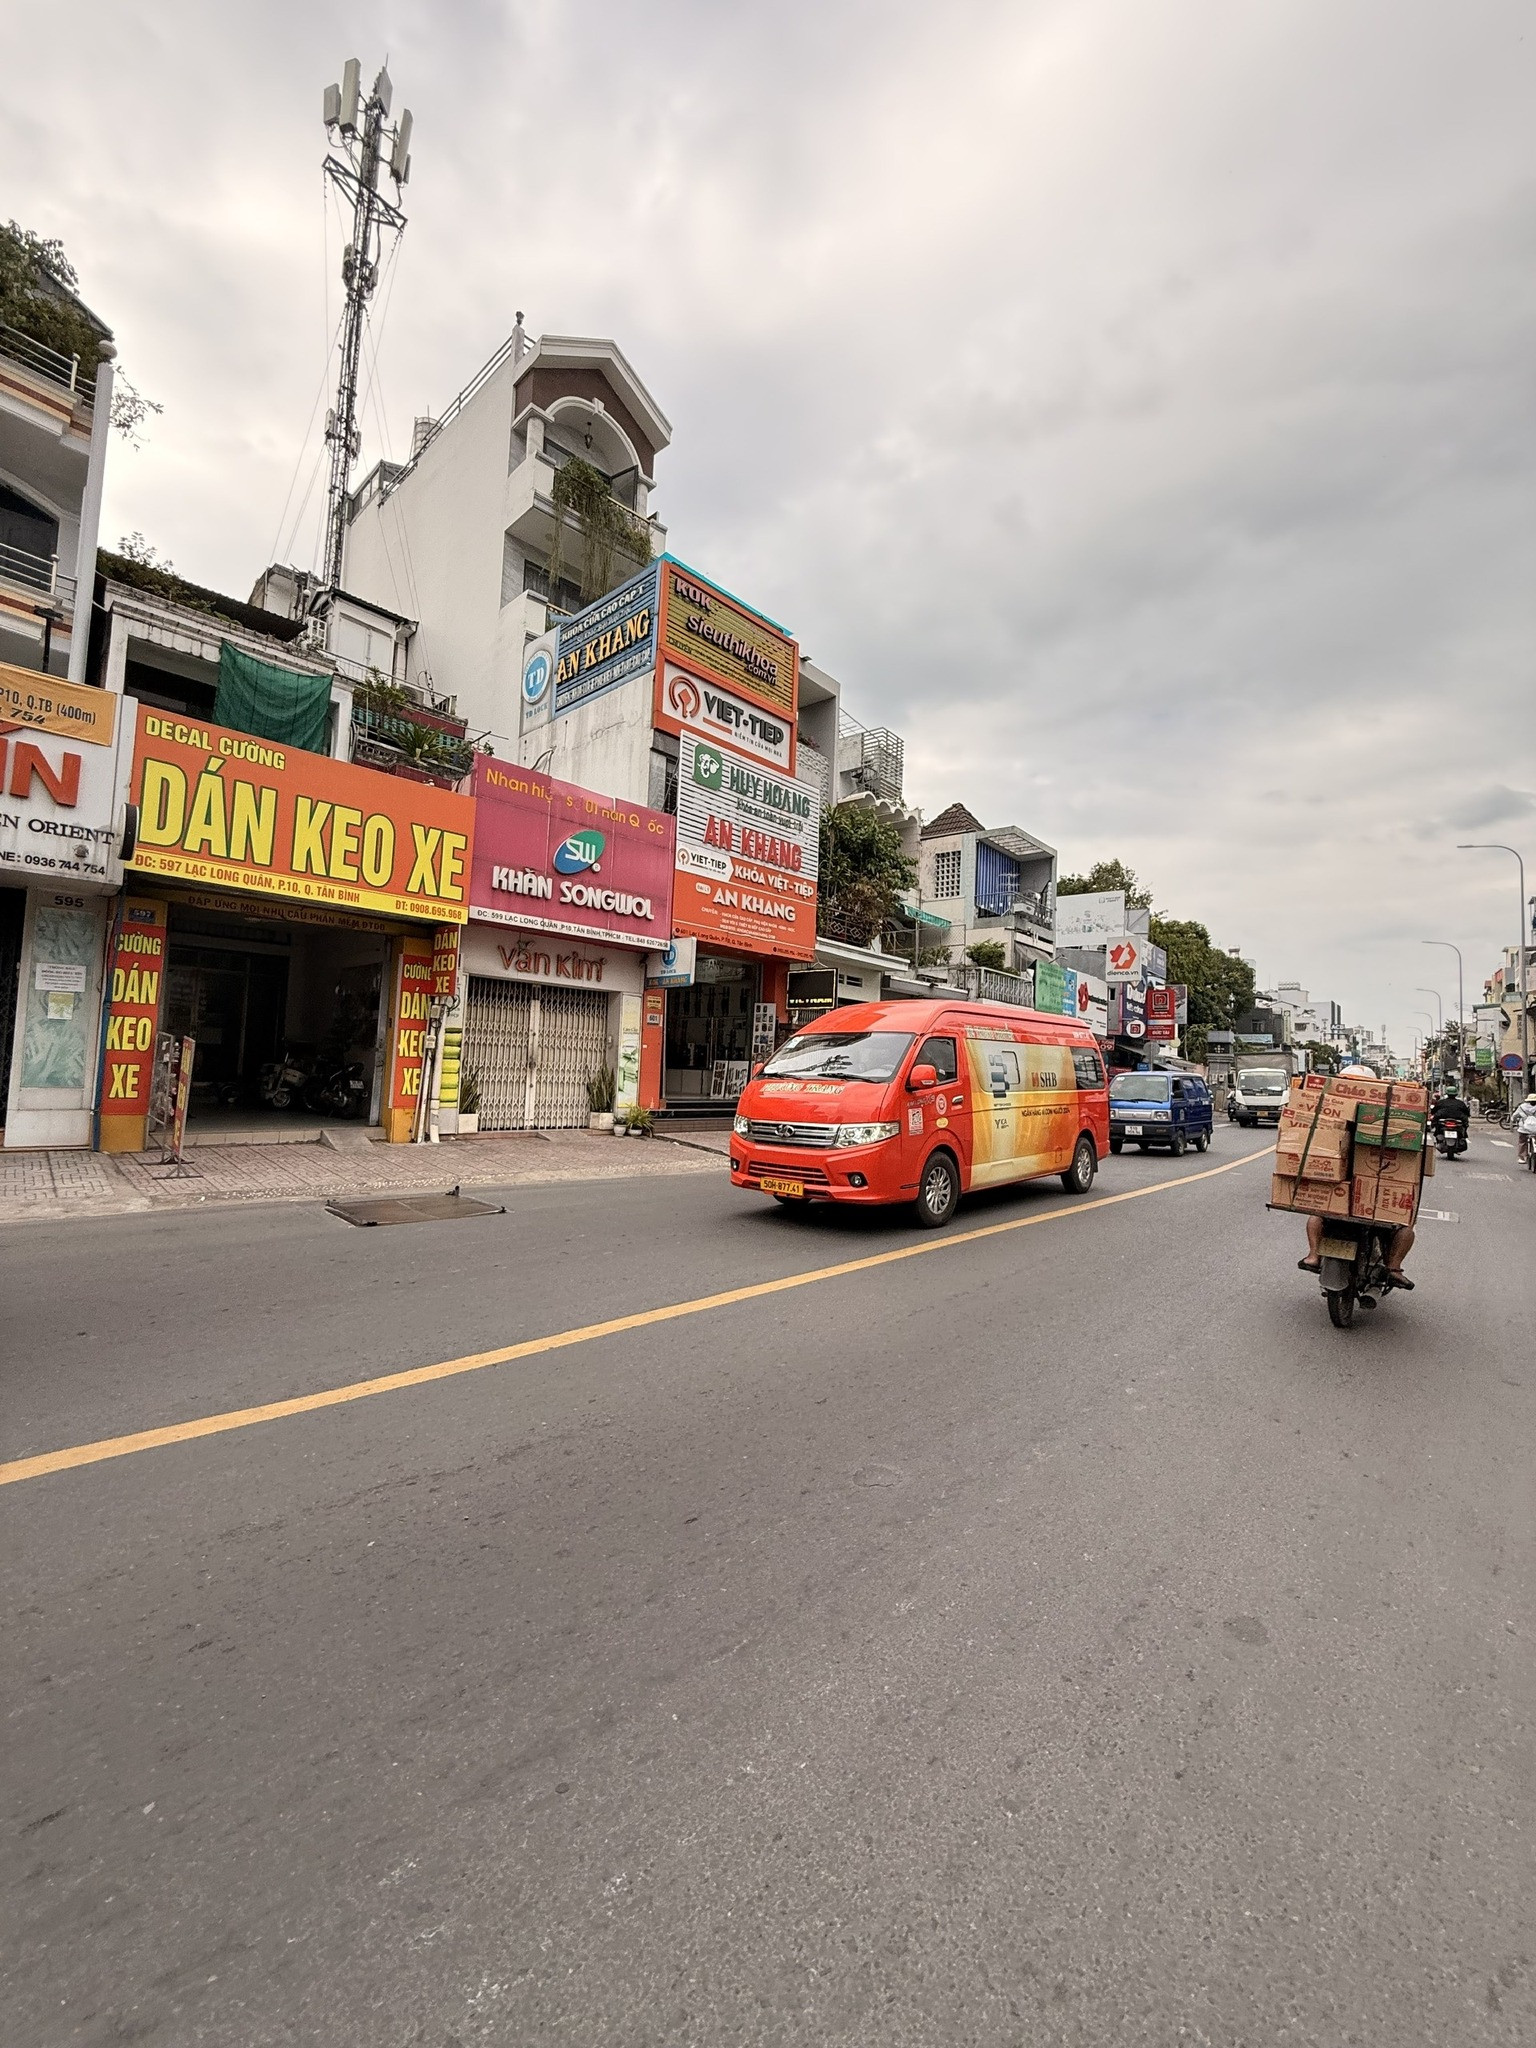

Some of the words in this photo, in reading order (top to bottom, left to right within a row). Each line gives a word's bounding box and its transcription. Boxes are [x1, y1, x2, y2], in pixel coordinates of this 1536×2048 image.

[601, 602, 618, 620] CAO
[556, 650, 581, 683] AN
[584, 608, 650, 669] KHANG
[686, 615, 779, 676] sieuthikhoa
[528, 667, 545, 689] TD
[746, 663, 777, 687] .com.vn
[10, 708, 46, 726] 754
[27, 695, 53, 714] Q.TB
[56, 702, 96, 726] (400m)
[145, 716, 213, 752] DECAL
[219, 739, 285, 770] CƯỜNG
[729, 766, 760, 799] HUY
[28, 818, 115, 846] ORIENT
[138, 755, 278, 868] DÁN
[291, 795, 395, 888] KEO
[406, 823, 467, 901] XE
[703, 815, 733, 852] AN
[740, 827, 803, 873] KHANG
[24, 855, 56, 869] 0936
[58, 859, 81, 872] 744
[83, 862, 106, 876] 754
[690, 851, 727, 870] VIET-TIEP
[734, 863, 765, 885] KHÓA
[134, 854, 157, 869] ĐC:
[159, 858, 182, 873] 597
[185, 862, 208, 879] LẠC
[210, 866, 240, 884] LONG
[243, 870, 275, 890] QUÂN,
[278, 878, 301, 894] P.10,
[304, 883, 314, 896] Q.
[316, 884, 336, 900] TÂN
[337, 886, 360, 903] BÌNH
[395, 898, 409, 912] ĐT:
[409, 901, 462, 921] 0908.695.968
[559, 881, 655, 921] SONGWOL
[713, 888, 738, 907] AN
[741, 894, 796, 922] KHANG
[491, 911, 503, 920] 599
[519, 916, 539, 927] LONG
[434, 929, 458, 950] DÁN
[433, 953, 455, 972] KEO
[112, 962, 159, 1005] DÁN
[435, 976, 450, 993] XE
[401, 988, 431, 1020] DÁN
[105, 1015, 153, 1052] KEO
[108, 1064, 140, 1099] XE
[401, 1067, 421, 1096] XE
[1039, 1072, 1058, 1088] SHB
